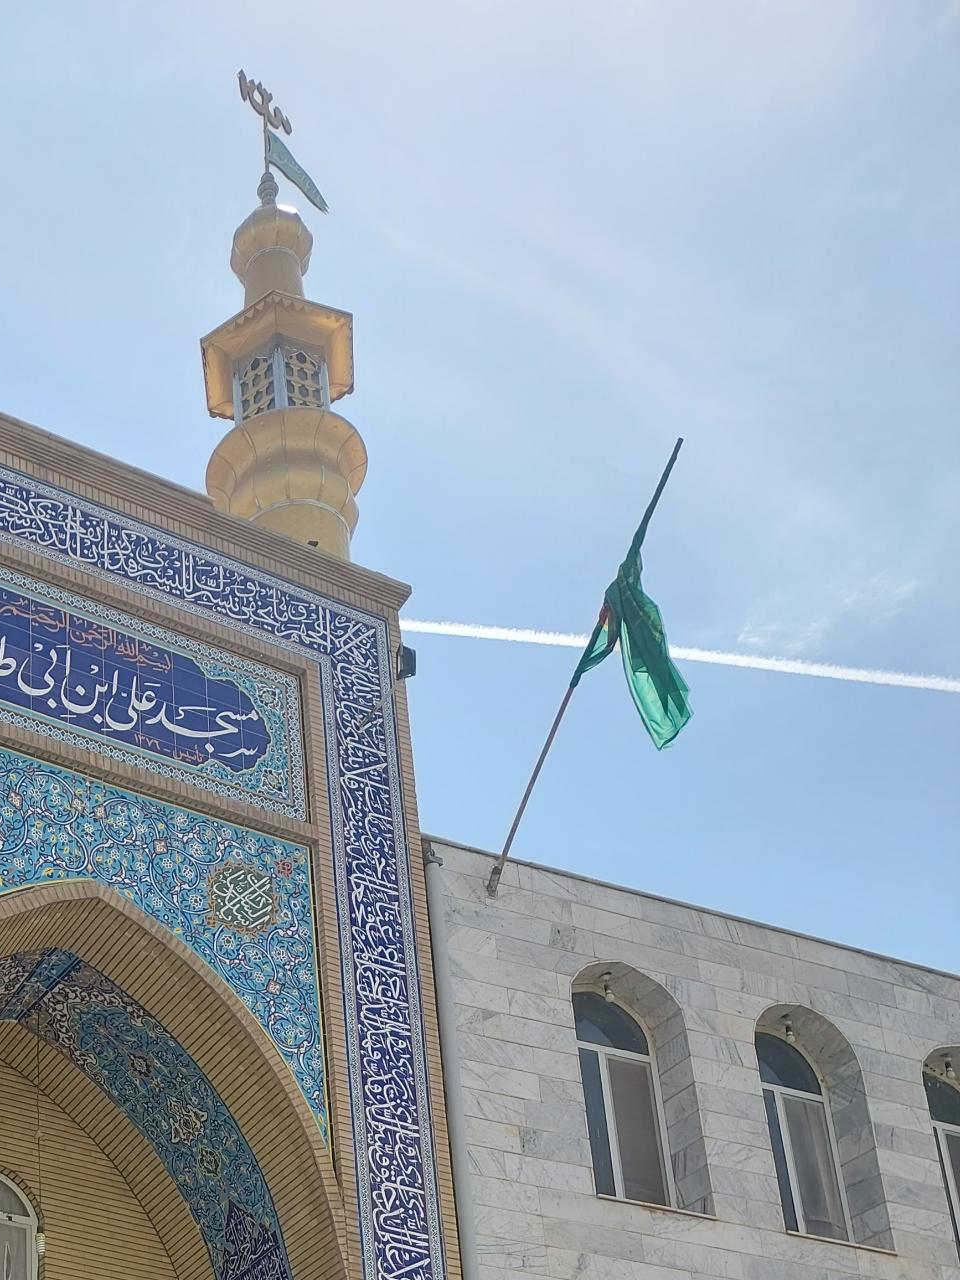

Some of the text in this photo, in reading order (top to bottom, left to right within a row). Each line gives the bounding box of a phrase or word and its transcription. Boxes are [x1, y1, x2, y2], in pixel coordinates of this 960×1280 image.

[115, 637, 140, 656] الله
[60, 668, 120, 724] ابن
[145, 701, 259, 753] مسجد
